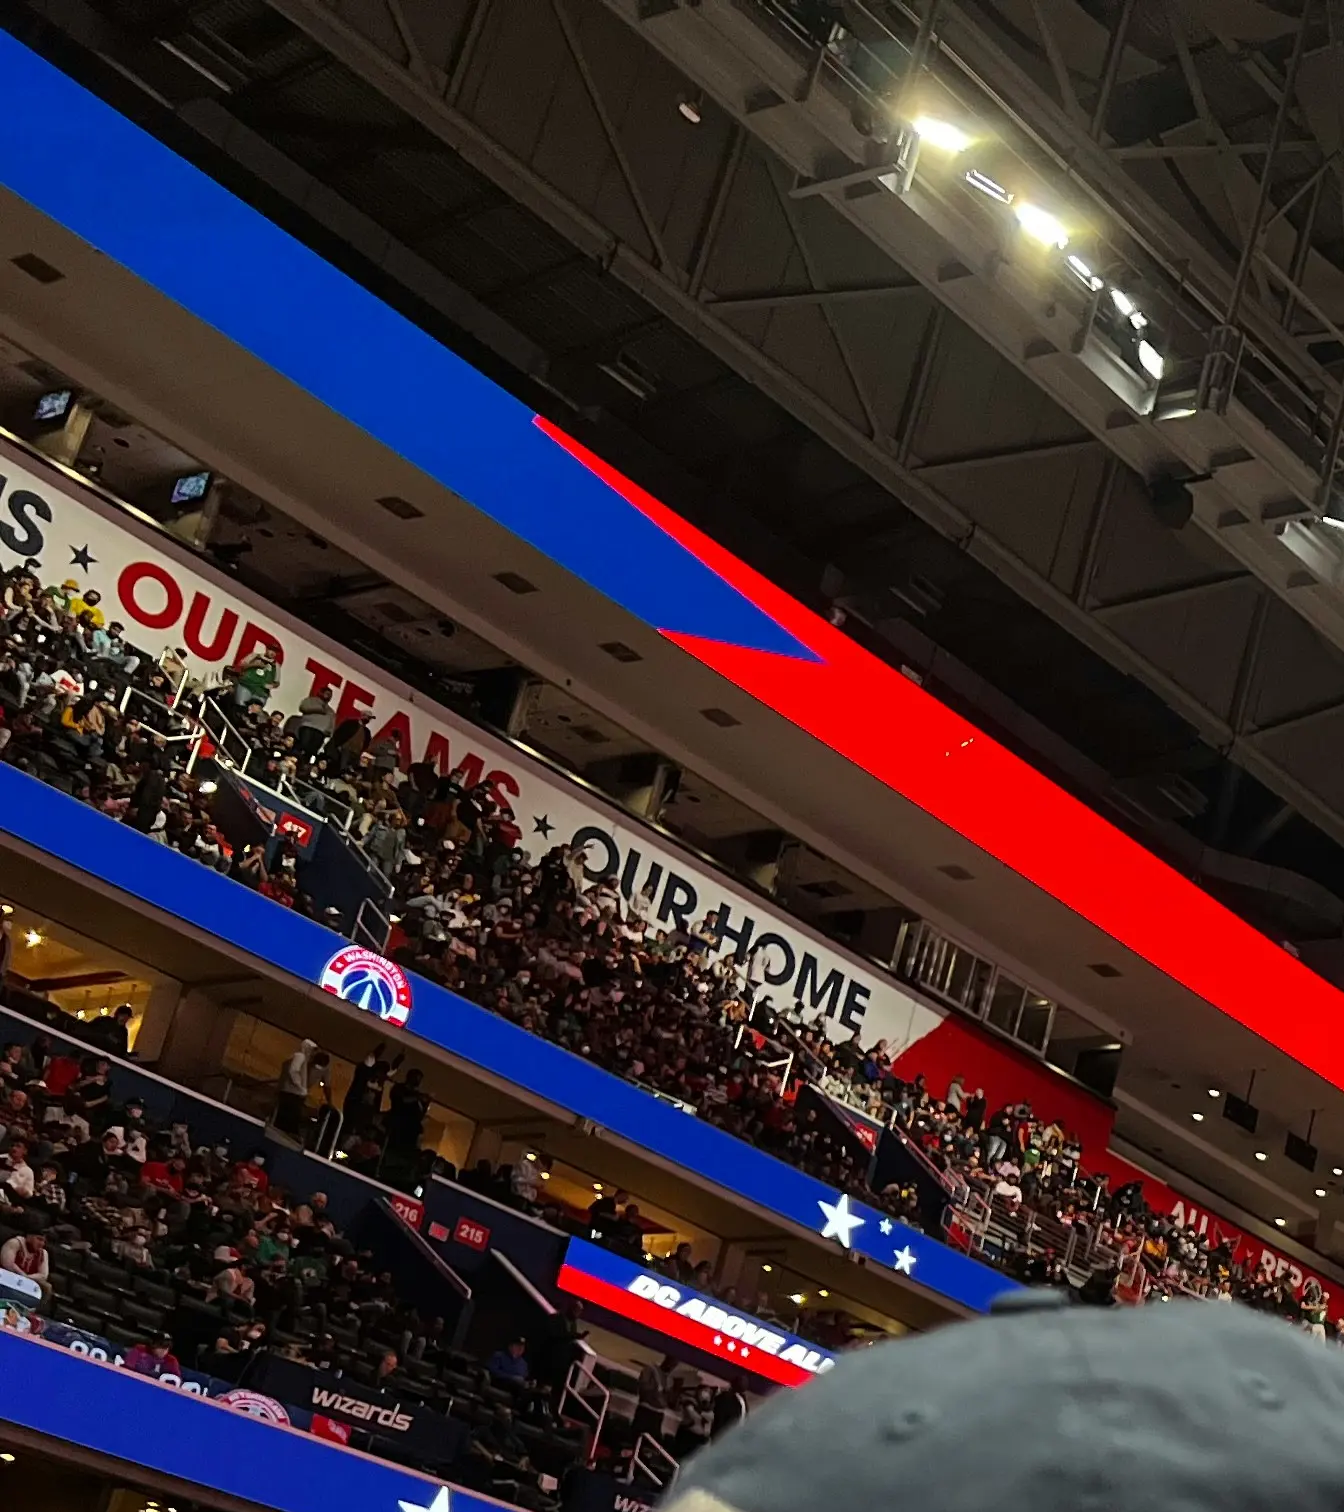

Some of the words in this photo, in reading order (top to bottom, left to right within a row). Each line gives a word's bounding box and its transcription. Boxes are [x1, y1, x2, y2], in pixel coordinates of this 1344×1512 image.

[571, 826, 698, 932] OUR
[714, 902, 872, 1034] HOME
[343, 949, 406, 988] WASHINGTON
[459, 1222, 484, 1243] 215
[627, 1273, 682, 1311] DC
[673, 1298, 787, 1356] ABOVE
